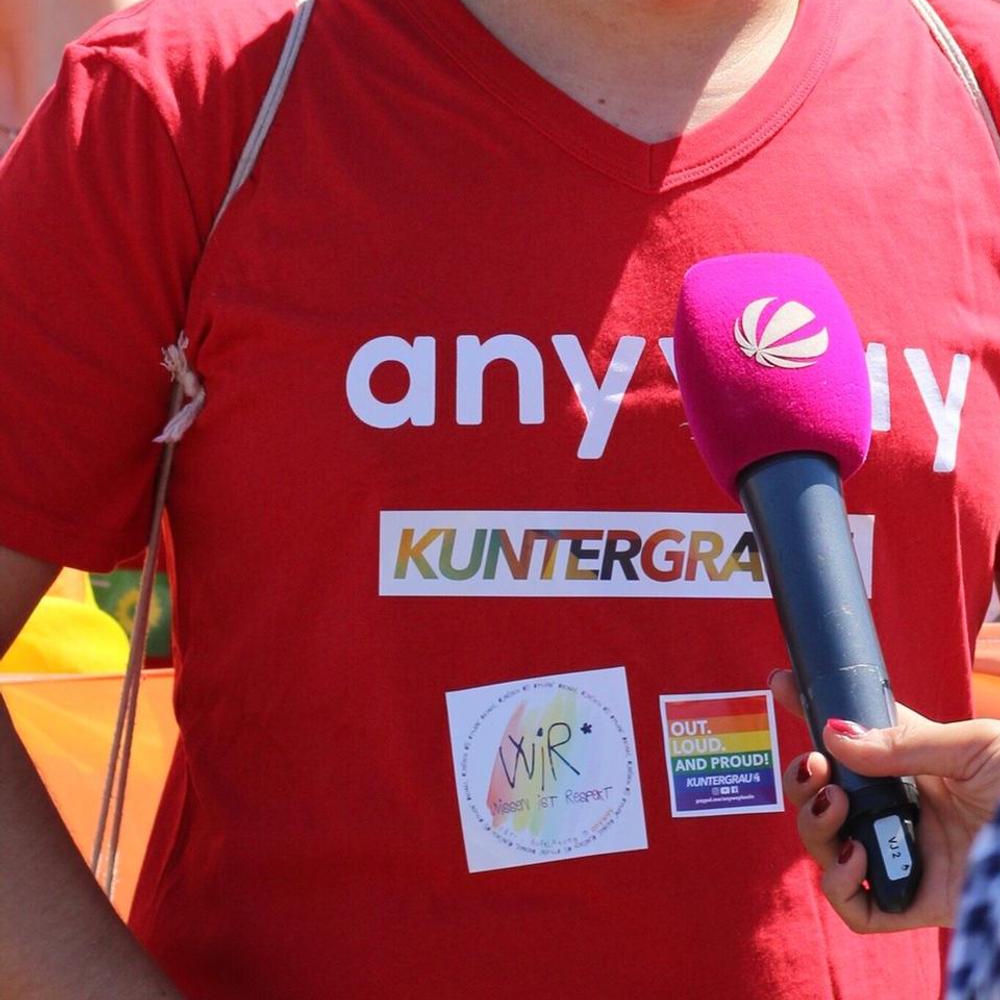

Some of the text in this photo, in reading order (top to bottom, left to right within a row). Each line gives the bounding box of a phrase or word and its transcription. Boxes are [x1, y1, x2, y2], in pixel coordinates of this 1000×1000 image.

[345, 333, 970, 473] anyy
[393, 528, 854, 581] KUNTERGRA
[671, 720, 712, 736] OUT.
[672, 738, 726, 754] LOUD.
[675, 754, 769, 771] AND PROUD!
[686, 774, 752, 787] KUNTERGRAU
